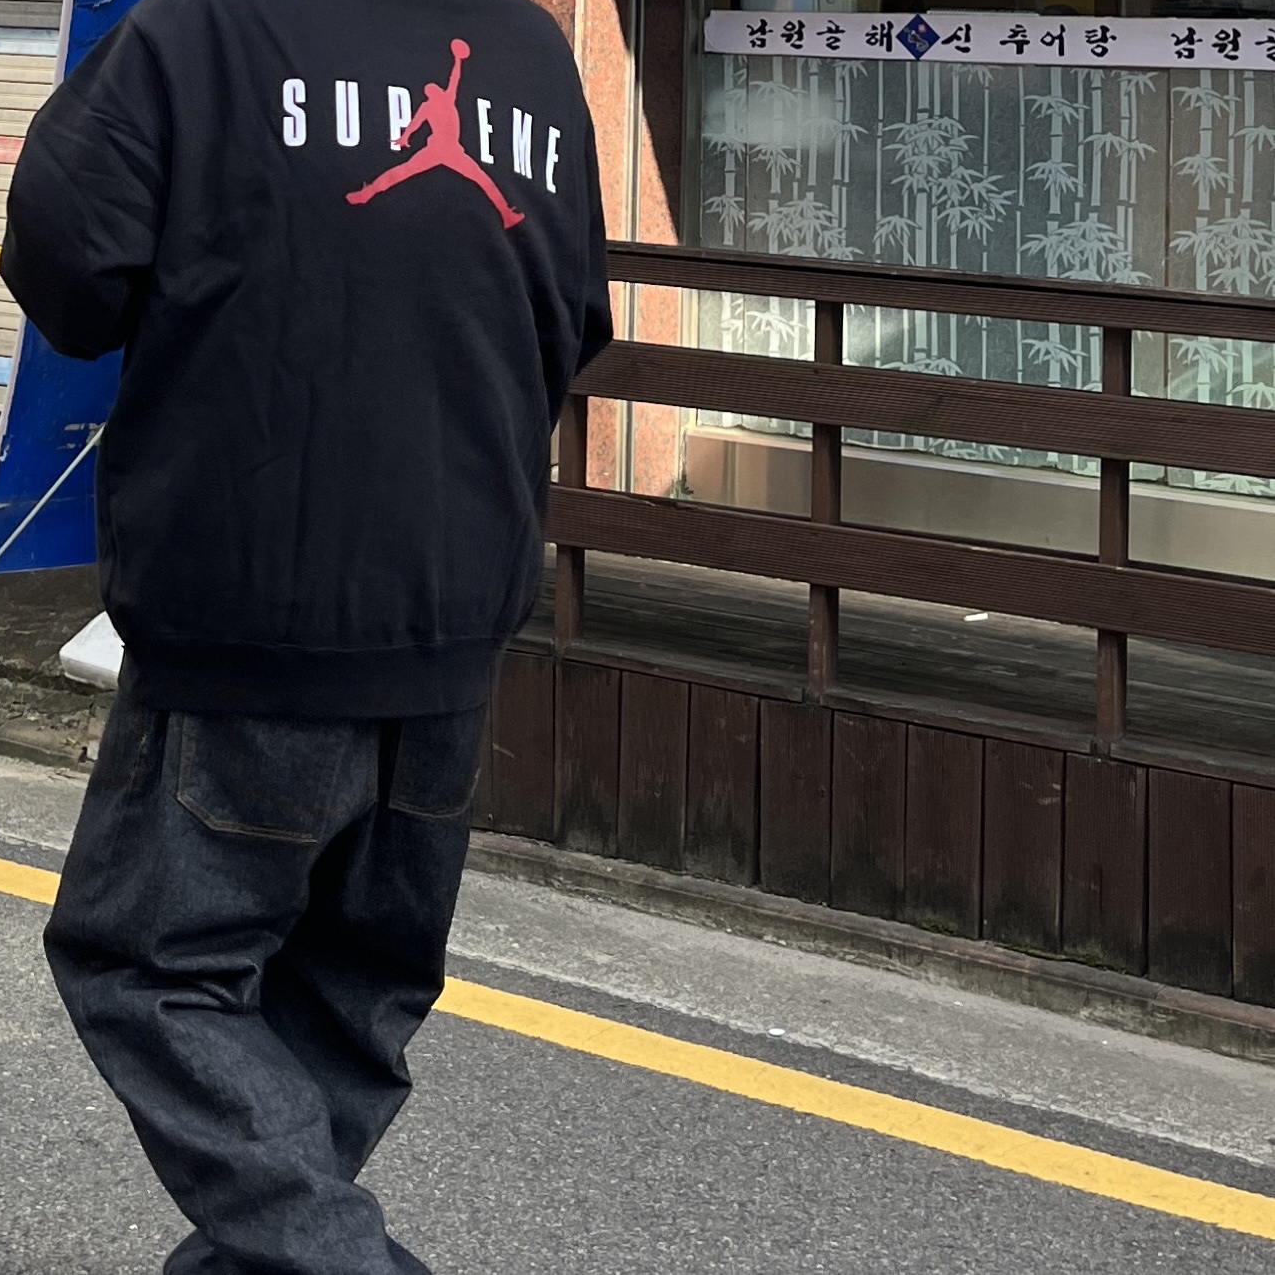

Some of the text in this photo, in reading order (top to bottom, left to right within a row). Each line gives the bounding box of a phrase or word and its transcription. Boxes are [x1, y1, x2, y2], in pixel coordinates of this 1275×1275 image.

[746, 18, 847, 52] 남원골
[998, 24, 1118, 59] 추어탕
[282, 78, 562, 195] SUPEME
